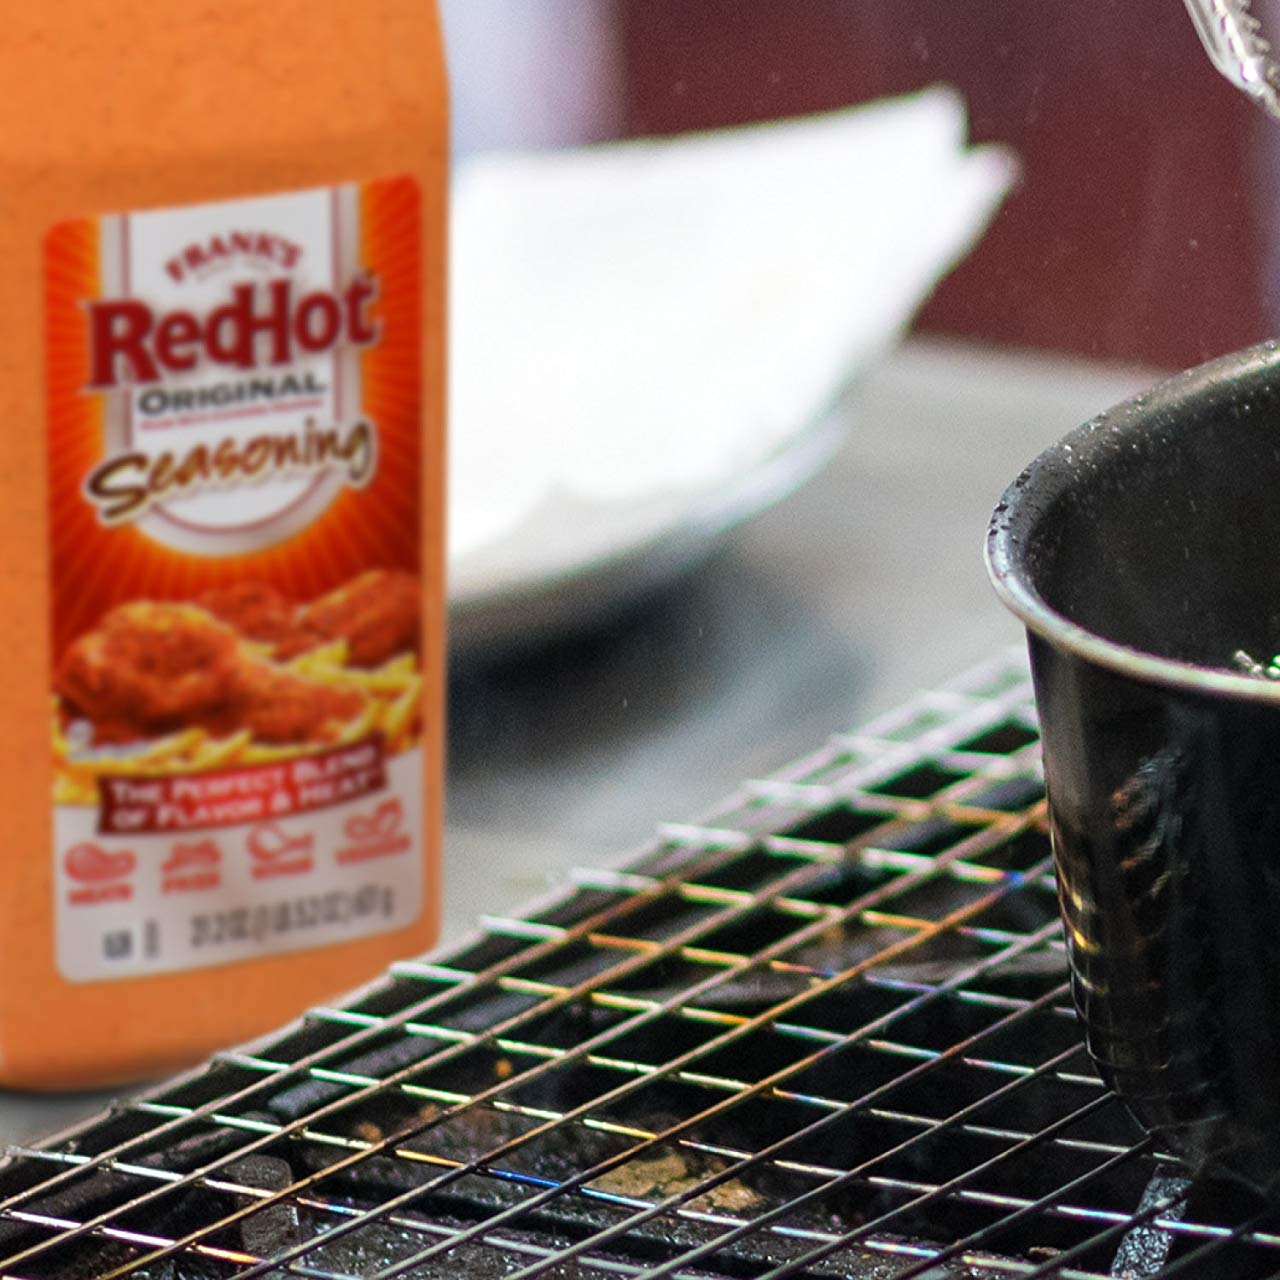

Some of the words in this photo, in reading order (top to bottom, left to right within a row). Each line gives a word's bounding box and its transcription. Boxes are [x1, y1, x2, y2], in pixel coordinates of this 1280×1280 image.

[164, 230, 302, 283] FRANK'S
[89, 278, 376, 388] RedHot
[138, 373, 326, 415] ORIGINAL
[88, 417, 372, 520] Seasoning
